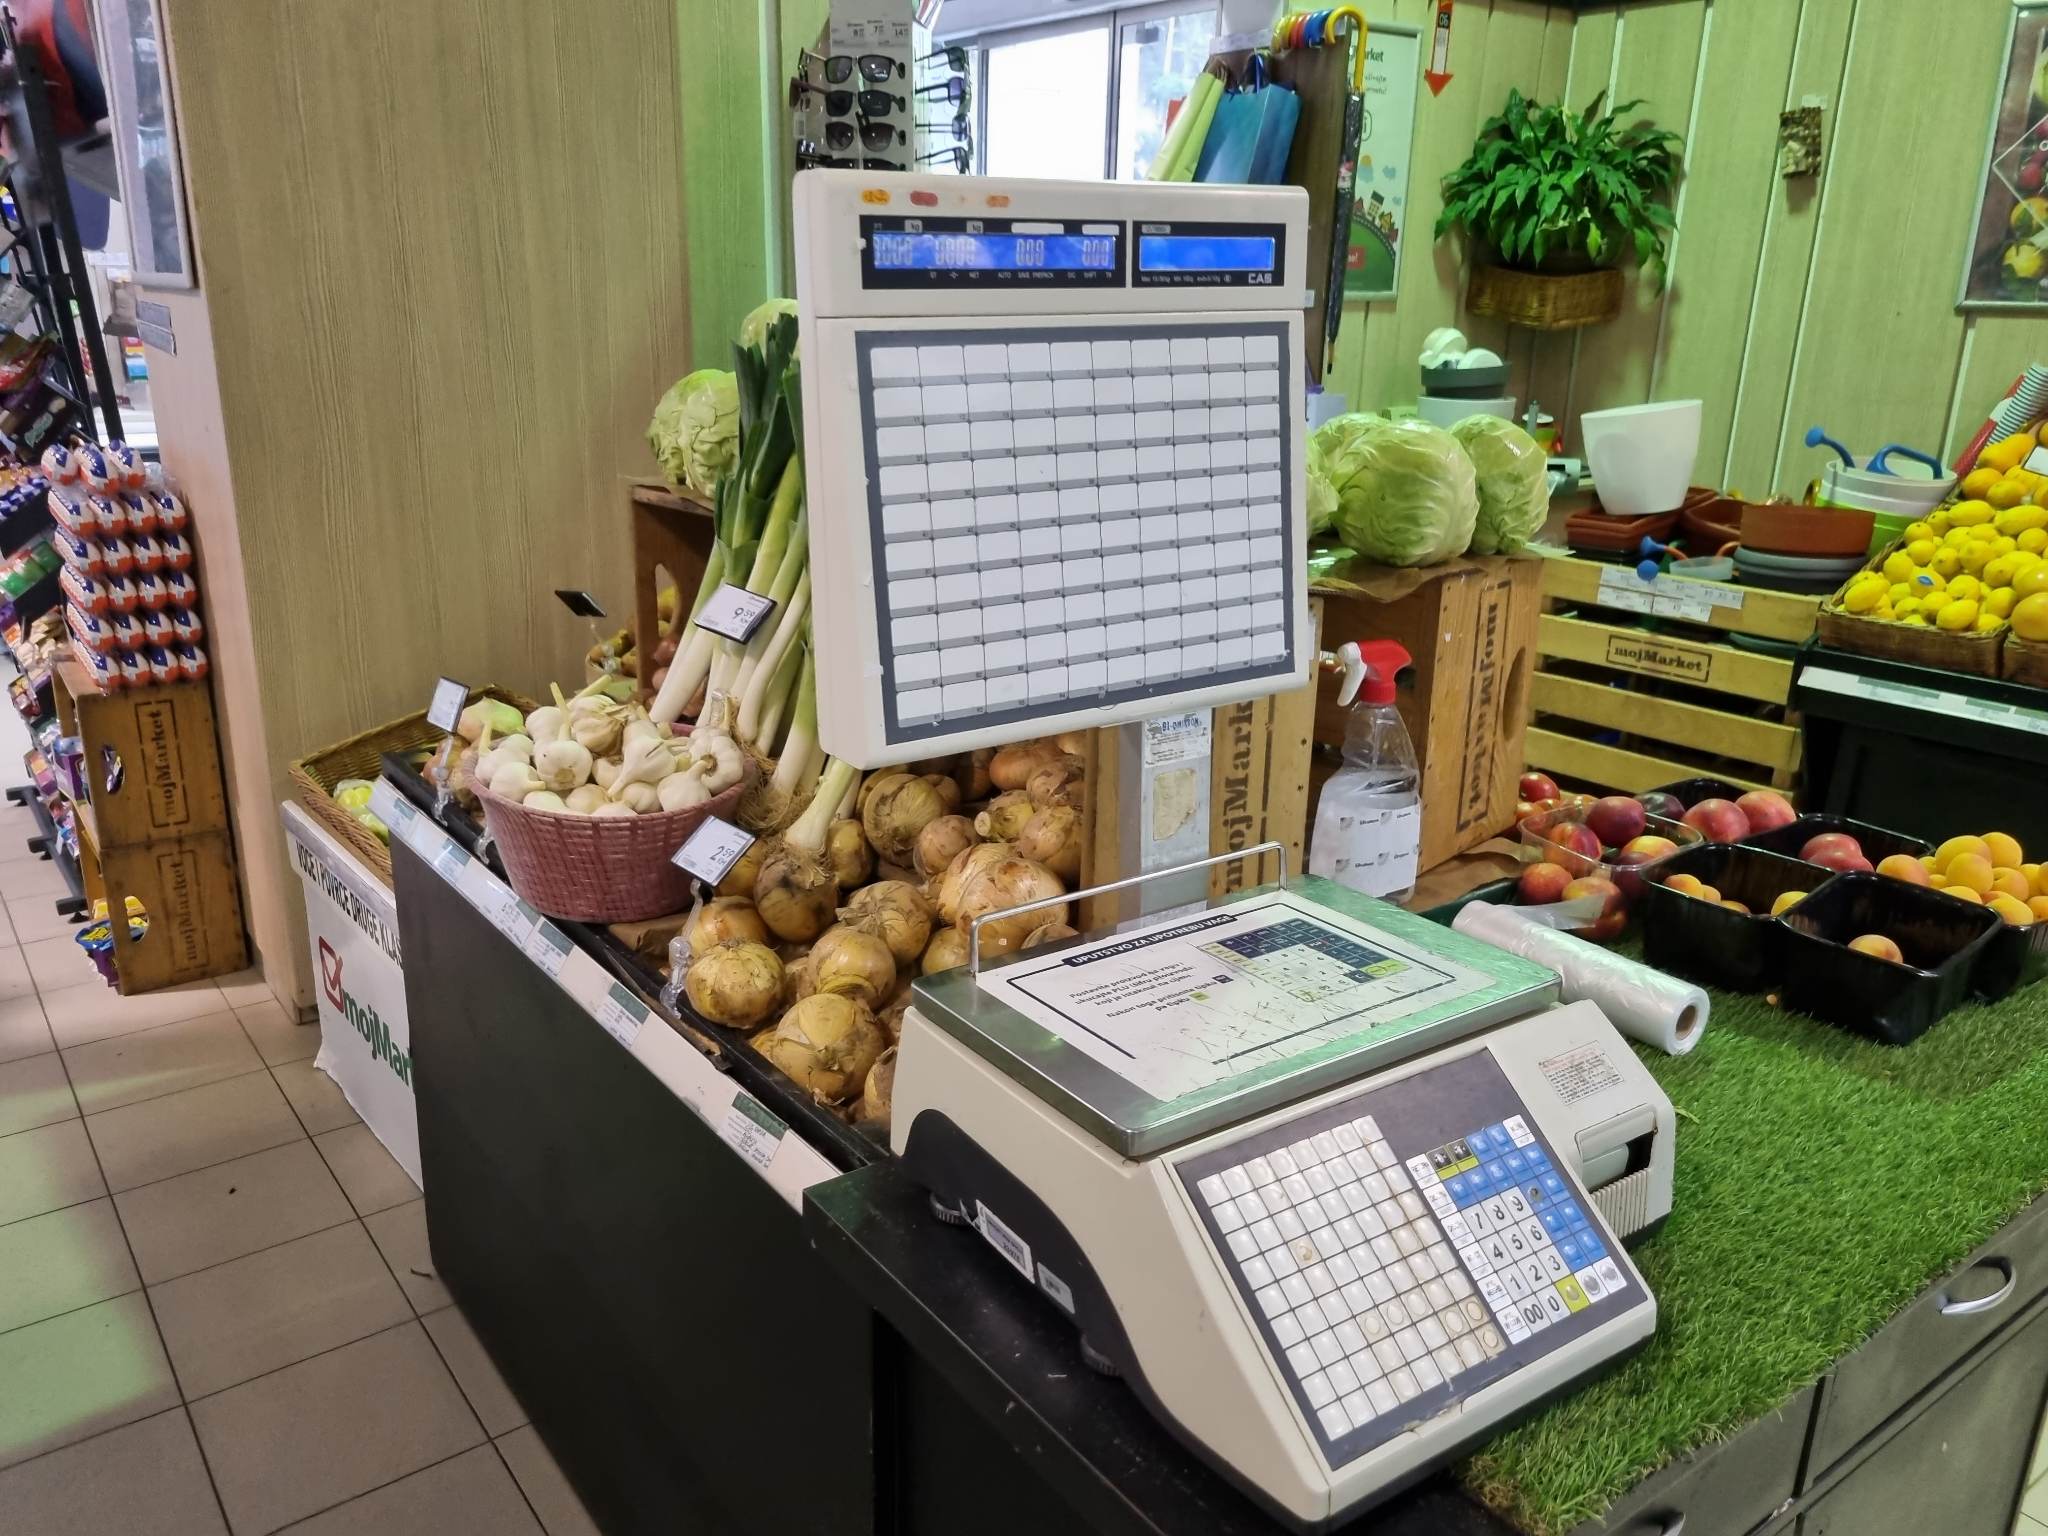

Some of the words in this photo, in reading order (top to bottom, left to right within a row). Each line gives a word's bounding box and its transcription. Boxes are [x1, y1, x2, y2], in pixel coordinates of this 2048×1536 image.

[1248, 272, 1272, 284] CAS
[1614, 646, 1703, 673] mojMarket
[146, 709, 178, 818] mojMarket
[709, 845, 725, 861] 2
[170, 858, 199, 961] mojMarket
[1073, 942, 1133, 964] UPUTSTVO
[1134, 938, 1151, 949] ZA
[1149, 923, 1201, 945] UPOTREBU
[342, 986, 414, 1088] mojMar
[1474, 1212, 1484, 1230] 7
[1492, 1204, 1505, 1220] 8
[1511, 1195, 1524, 1212] 9
[1493, 1242, 1504, 1260] 4
[1511, 1233, 1524, 1251] 5
[1530, 1224, 1543, 1242] 6
[1510, 1273, 1522, 1291] 1
[1528, 1264, 1543, 1282] 2
[1547, 1255, 1561, 1272] 3
[1523, 1302, 1544, 1325] 00
[1548, 1295, 1560, 1312] 0
